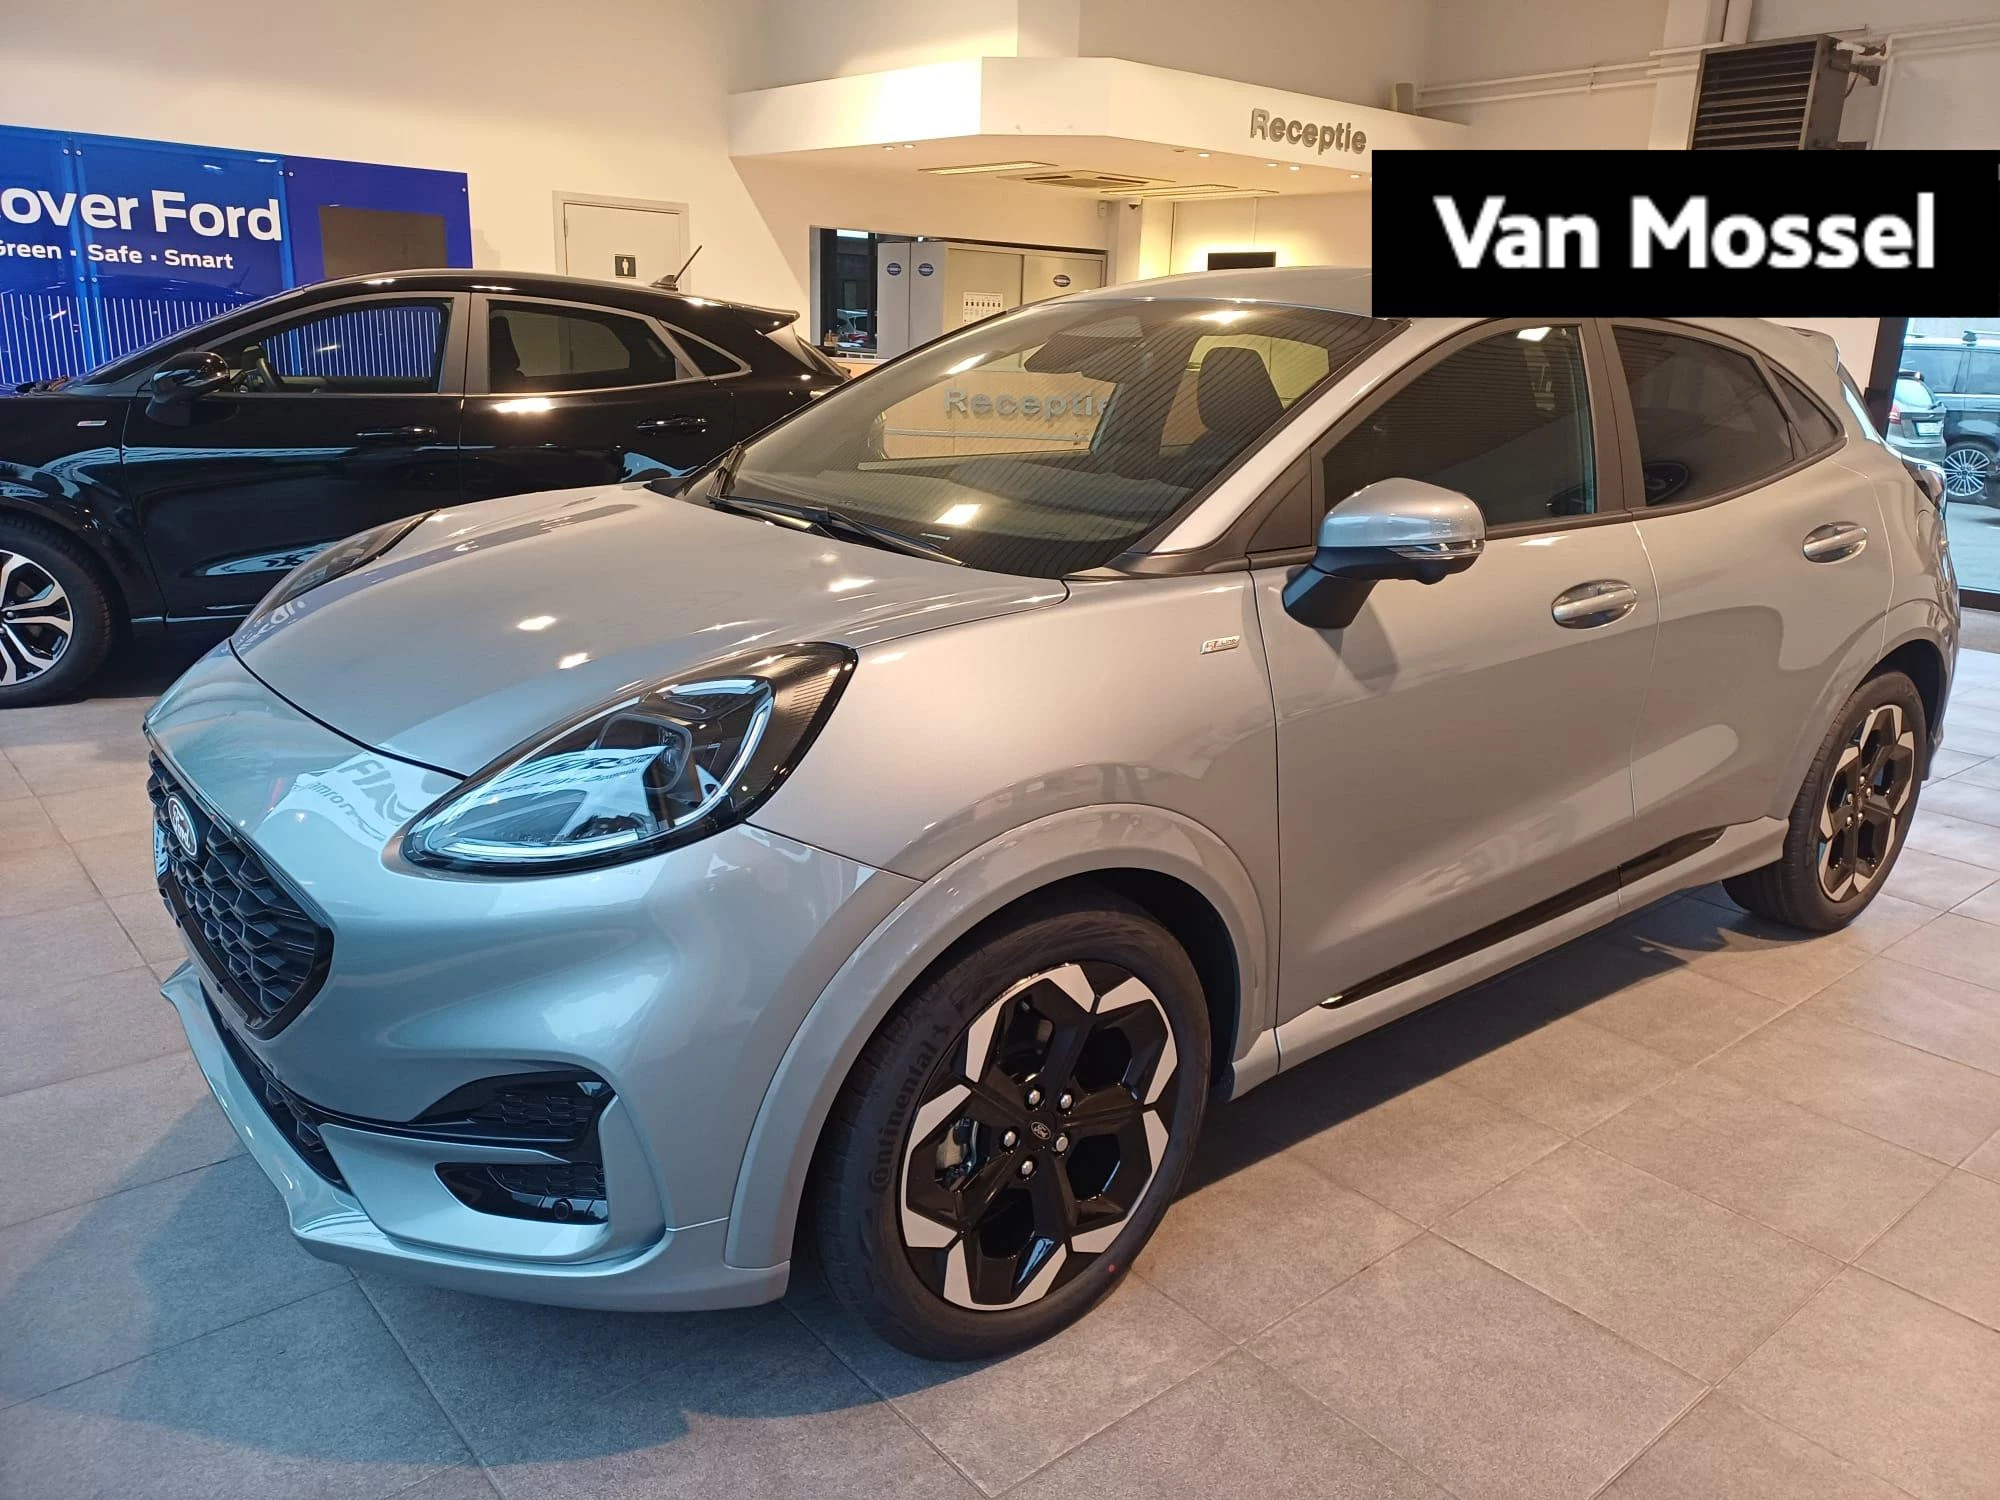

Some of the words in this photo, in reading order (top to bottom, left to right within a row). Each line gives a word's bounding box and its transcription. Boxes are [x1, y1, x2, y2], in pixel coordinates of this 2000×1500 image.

[1250, 108, 1366, 155] Receptie
[0, 187, 139, 231] over
[151, 190, 282, 241] Ford
[88, 244, 143, 264] Safe
[165, 249, 234, 269] Smart
[868, 1038, 939, 1193] Continental
